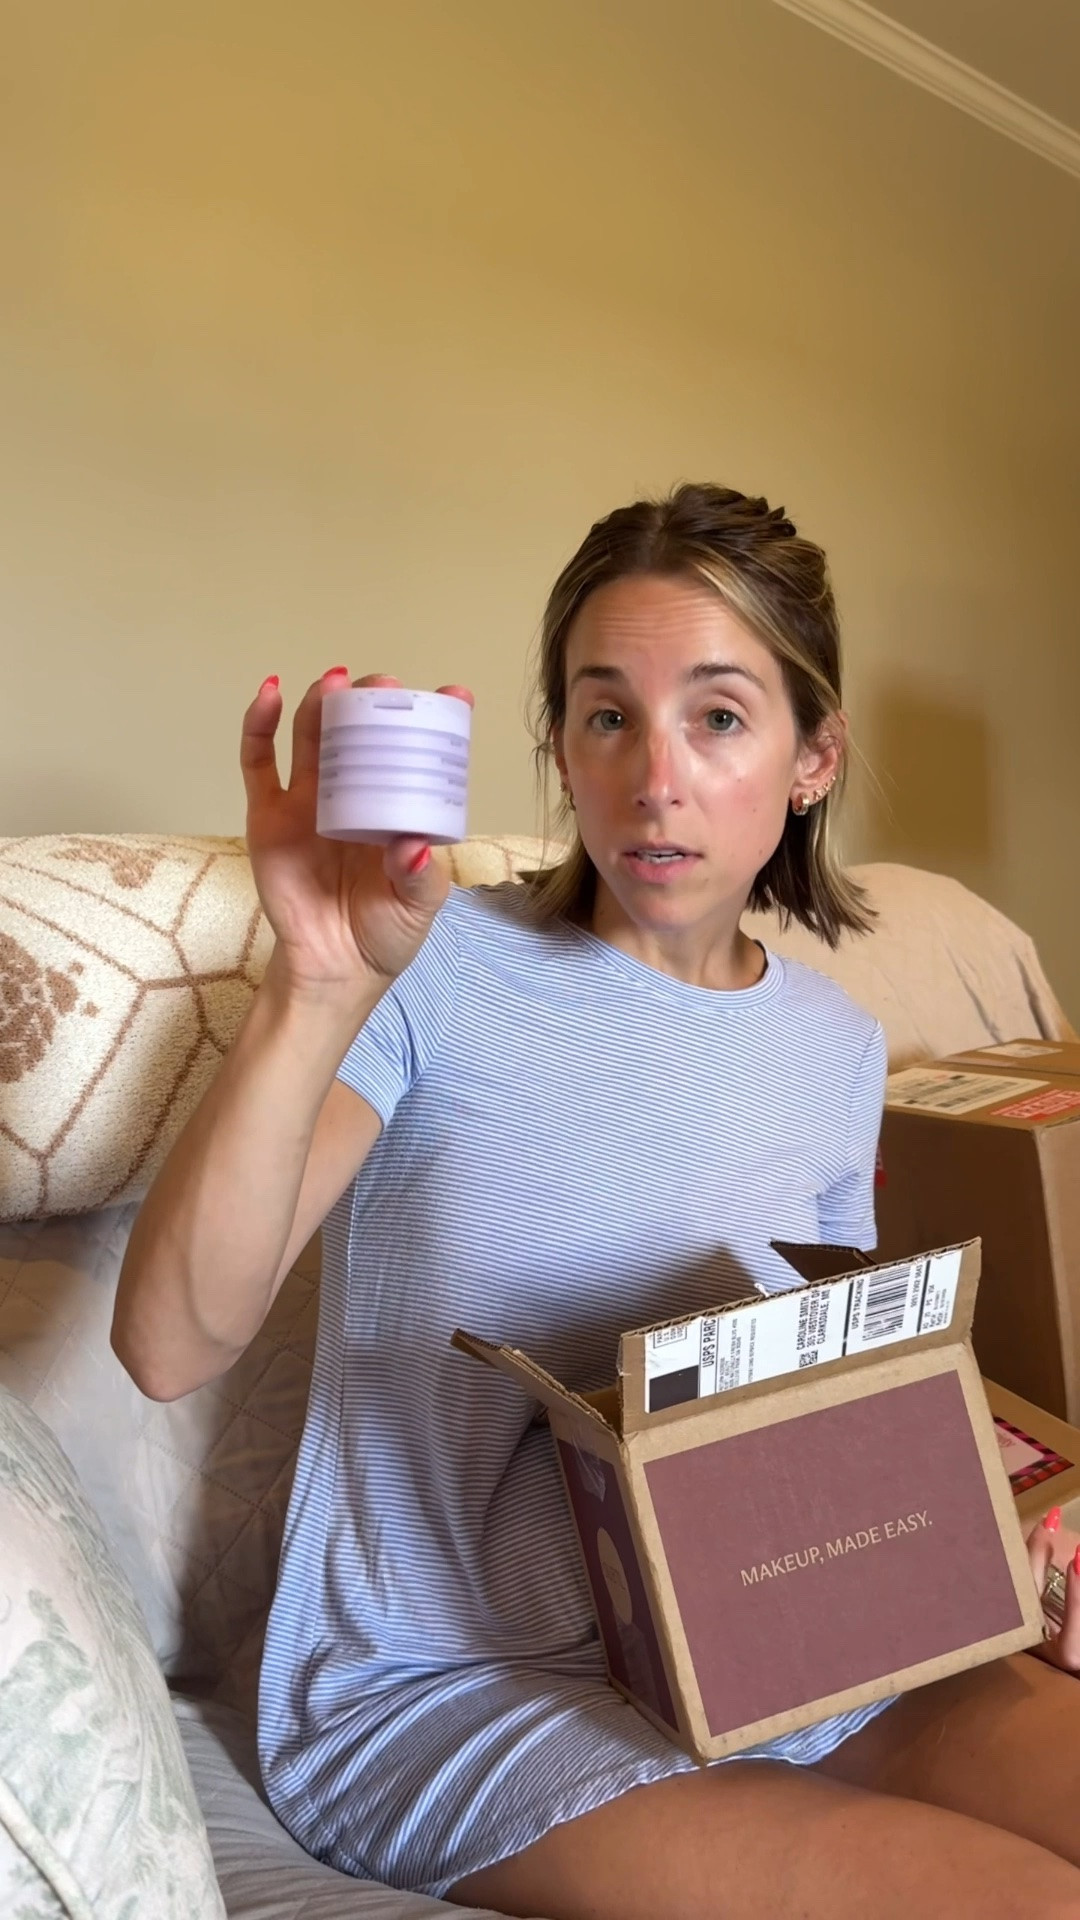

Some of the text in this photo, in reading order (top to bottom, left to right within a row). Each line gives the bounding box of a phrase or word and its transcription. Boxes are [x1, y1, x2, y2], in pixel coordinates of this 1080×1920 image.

[796, 1295, 809, 1350] CAROLINE SMITH
[807, 1298, 819, 1335] WESTOVER
[851, 1278, 864, 1329] USPS TRACKING
[702, 1318, 715, 1367] USPS PARC
[740, 1510, 933, 1586] MAKEUP, MADE EASY.
